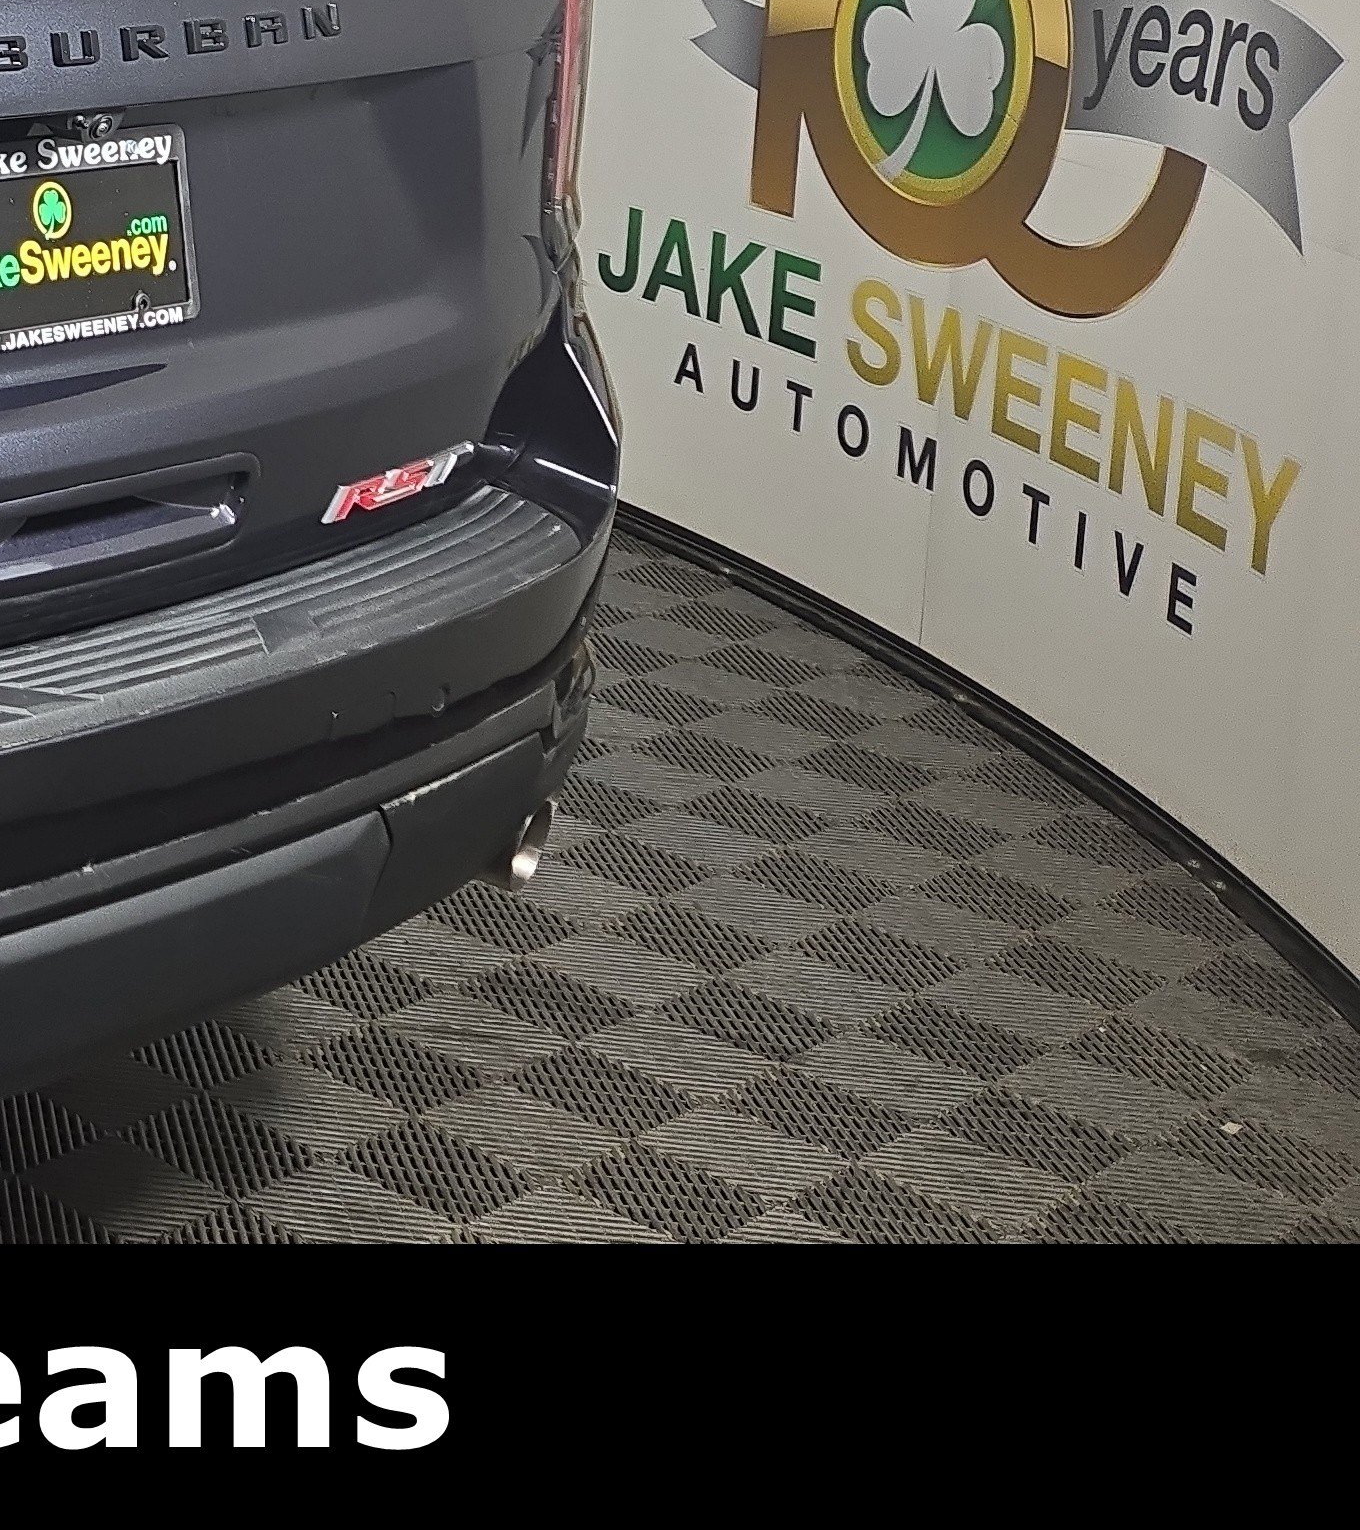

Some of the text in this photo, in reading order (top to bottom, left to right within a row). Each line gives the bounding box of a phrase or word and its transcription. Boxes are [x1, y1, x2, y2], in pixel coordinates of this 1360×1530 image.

[1083, 3, 1280, 132] years
[37, 134, 172, 170] Sweeney
[127, 215, 168, 237] .com
[597, 206, 1302, 576] JAKE SWEENEY
[321, 440, 475, 525] RST
[674, 342, 1199, 636] AUTOMOTIVE
